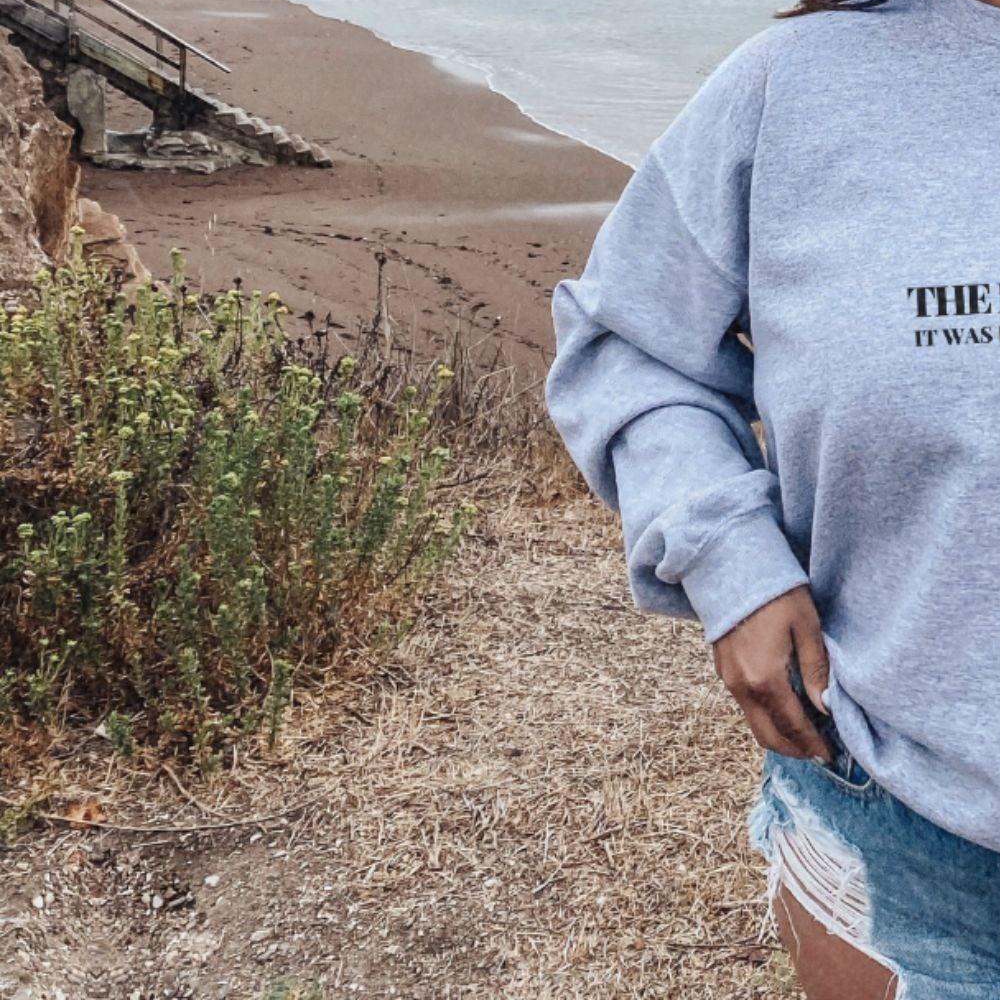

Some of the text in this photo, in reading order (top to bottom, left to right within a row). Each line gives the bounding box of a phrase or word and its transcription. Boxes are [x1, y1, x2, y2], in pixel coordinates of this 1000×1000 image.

[907, 283, 992, 317] THE
[914, 329, 938, 347] IT
[942, 326, 993, 346] WAS
